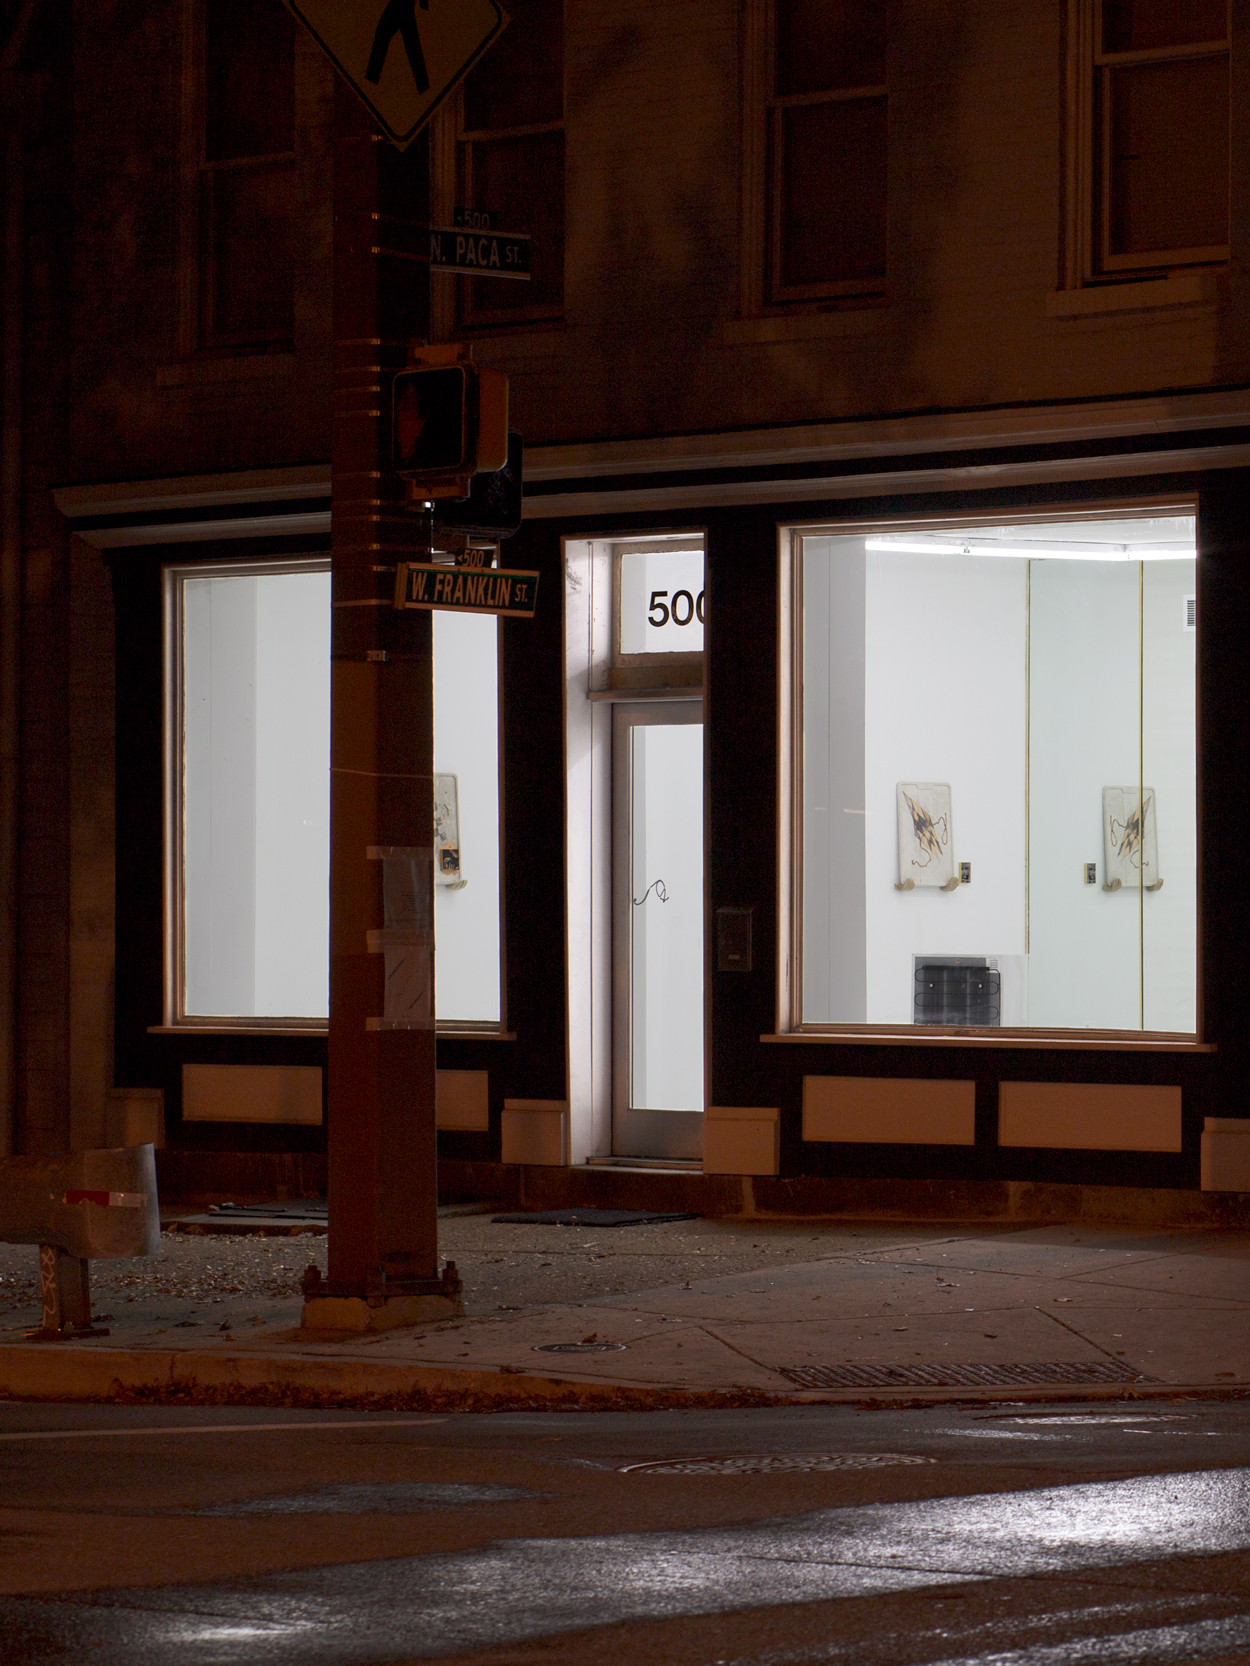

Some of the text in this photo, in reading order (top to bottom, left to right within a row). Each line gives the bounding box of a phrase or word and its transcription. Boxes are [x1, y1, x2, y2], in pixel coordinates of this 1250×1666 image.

[464, 210, 490, 230] 500
[429, 233, 522, 268] N. PACA ST.
[463, 550, 484, 567] 500
[412, 571, 528, 607] W. FRANKLIN ST.
